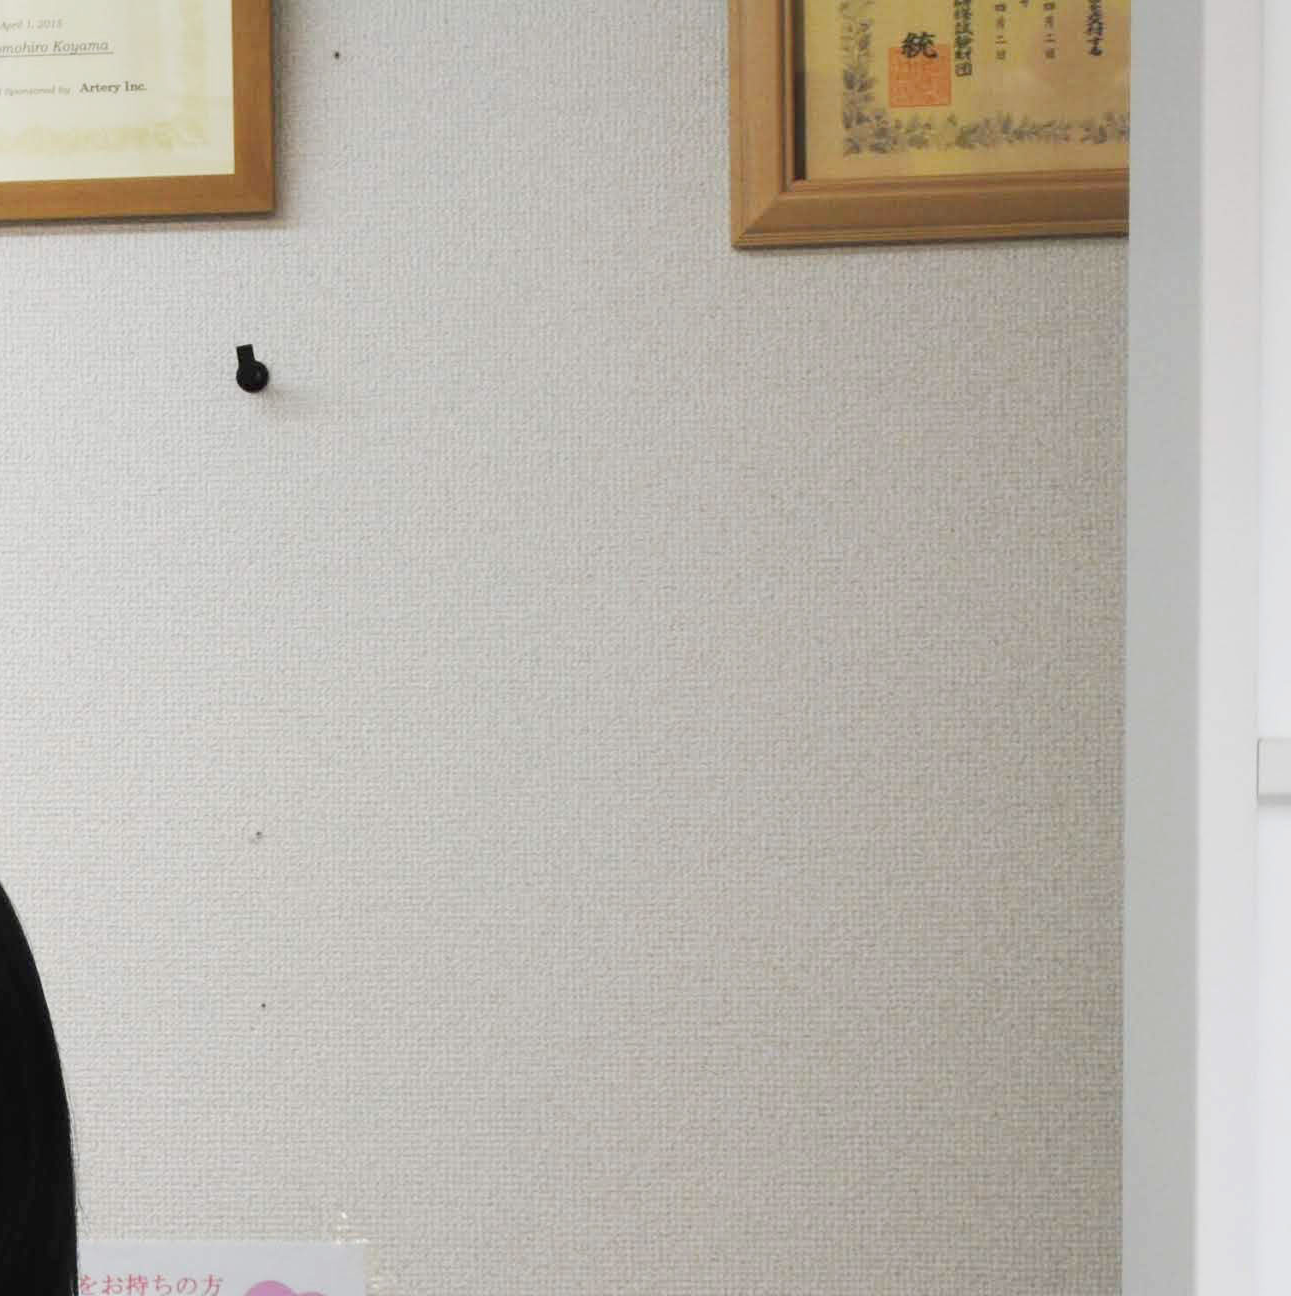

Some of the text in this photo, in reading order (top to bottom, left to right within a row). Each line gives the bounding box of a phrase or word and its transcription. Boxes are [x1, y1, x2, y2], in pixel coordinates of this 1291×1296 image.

[52, 39, 111, 55] Koyama
[79, 82, 121, 95] Artery
[124, 80, 148, 92] Inc.
[80, 1274, 223, 1296] をお持ちの方
